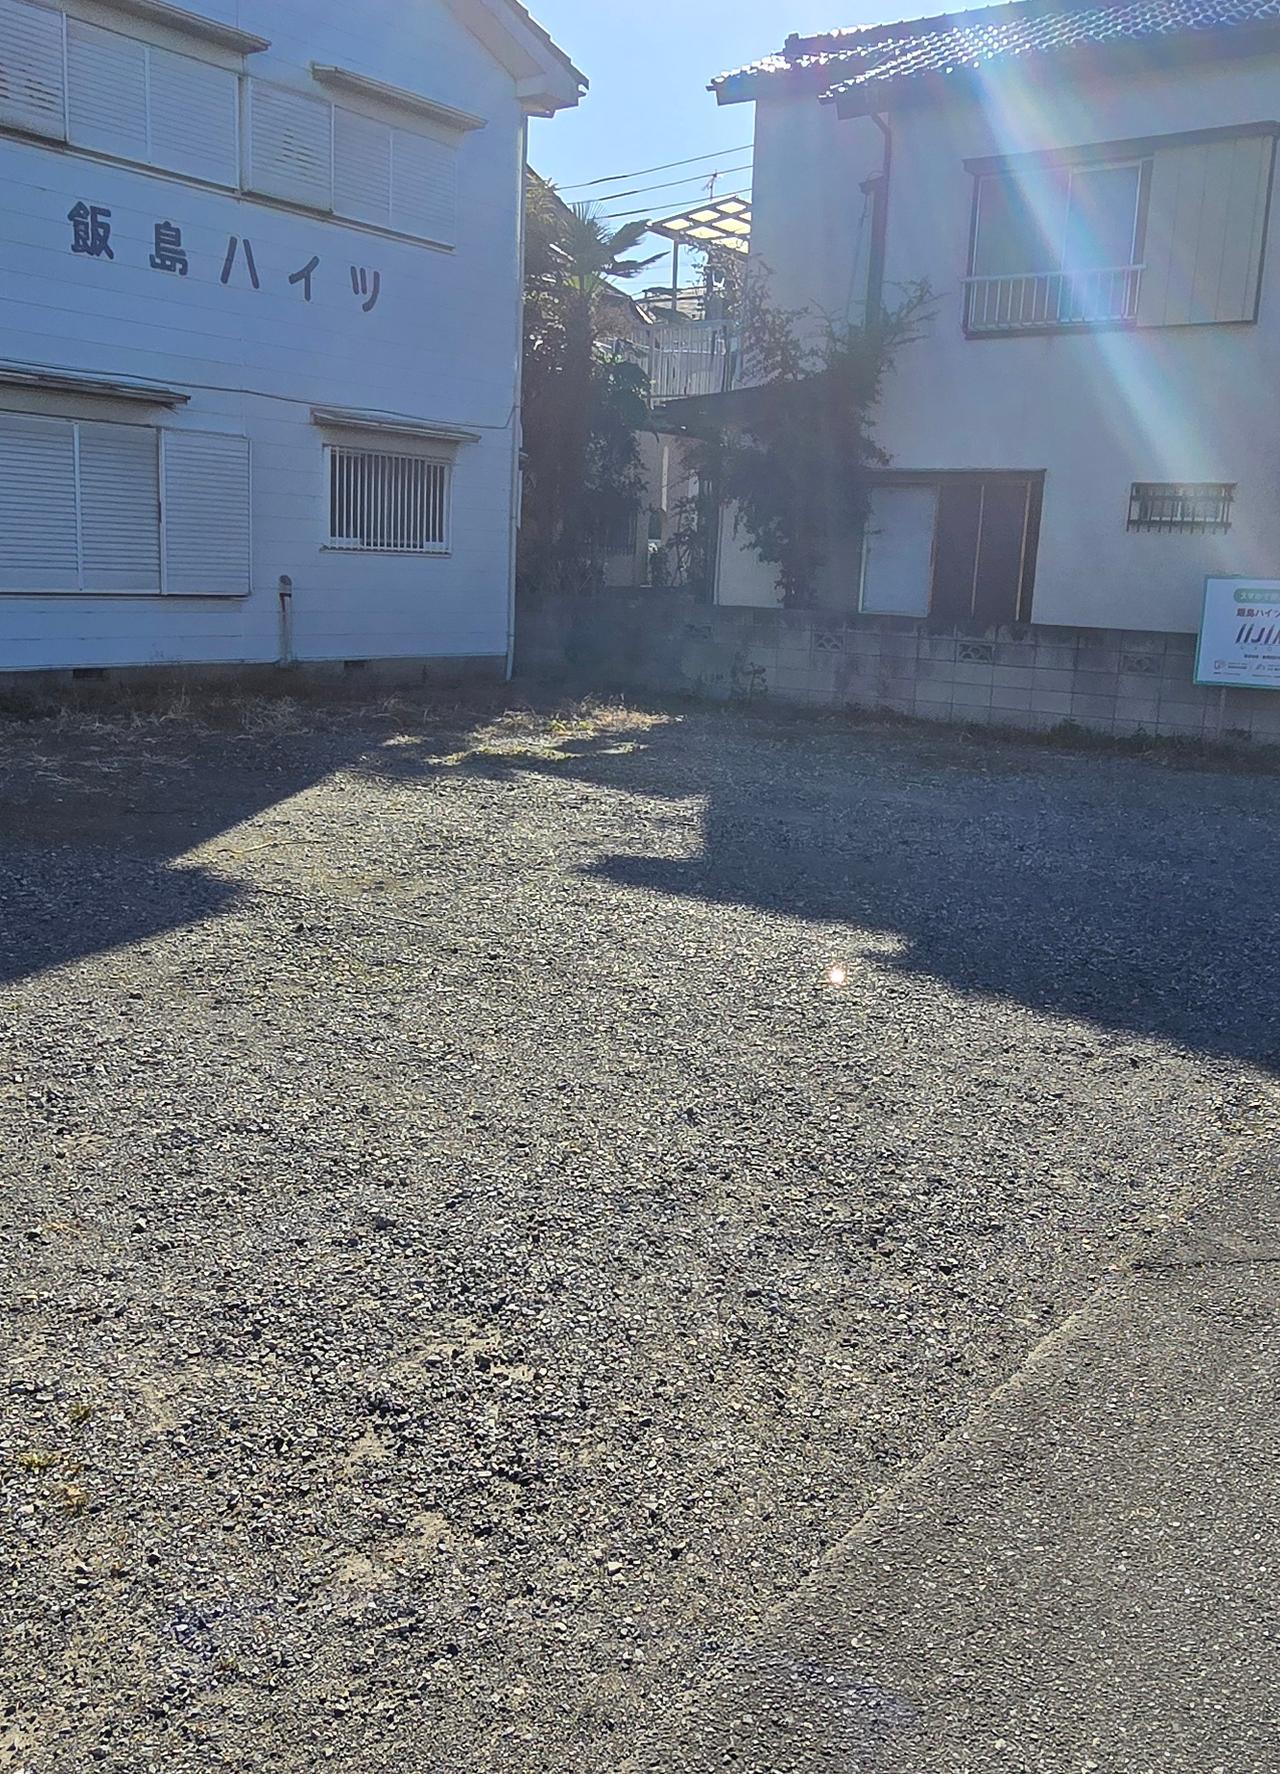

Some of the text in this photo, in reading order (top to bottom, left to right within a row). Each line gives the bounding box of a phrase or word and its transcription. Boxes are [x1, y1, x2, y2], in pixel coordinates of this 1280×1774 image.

[67, 200, 381, 313] 飯島ハイツ
